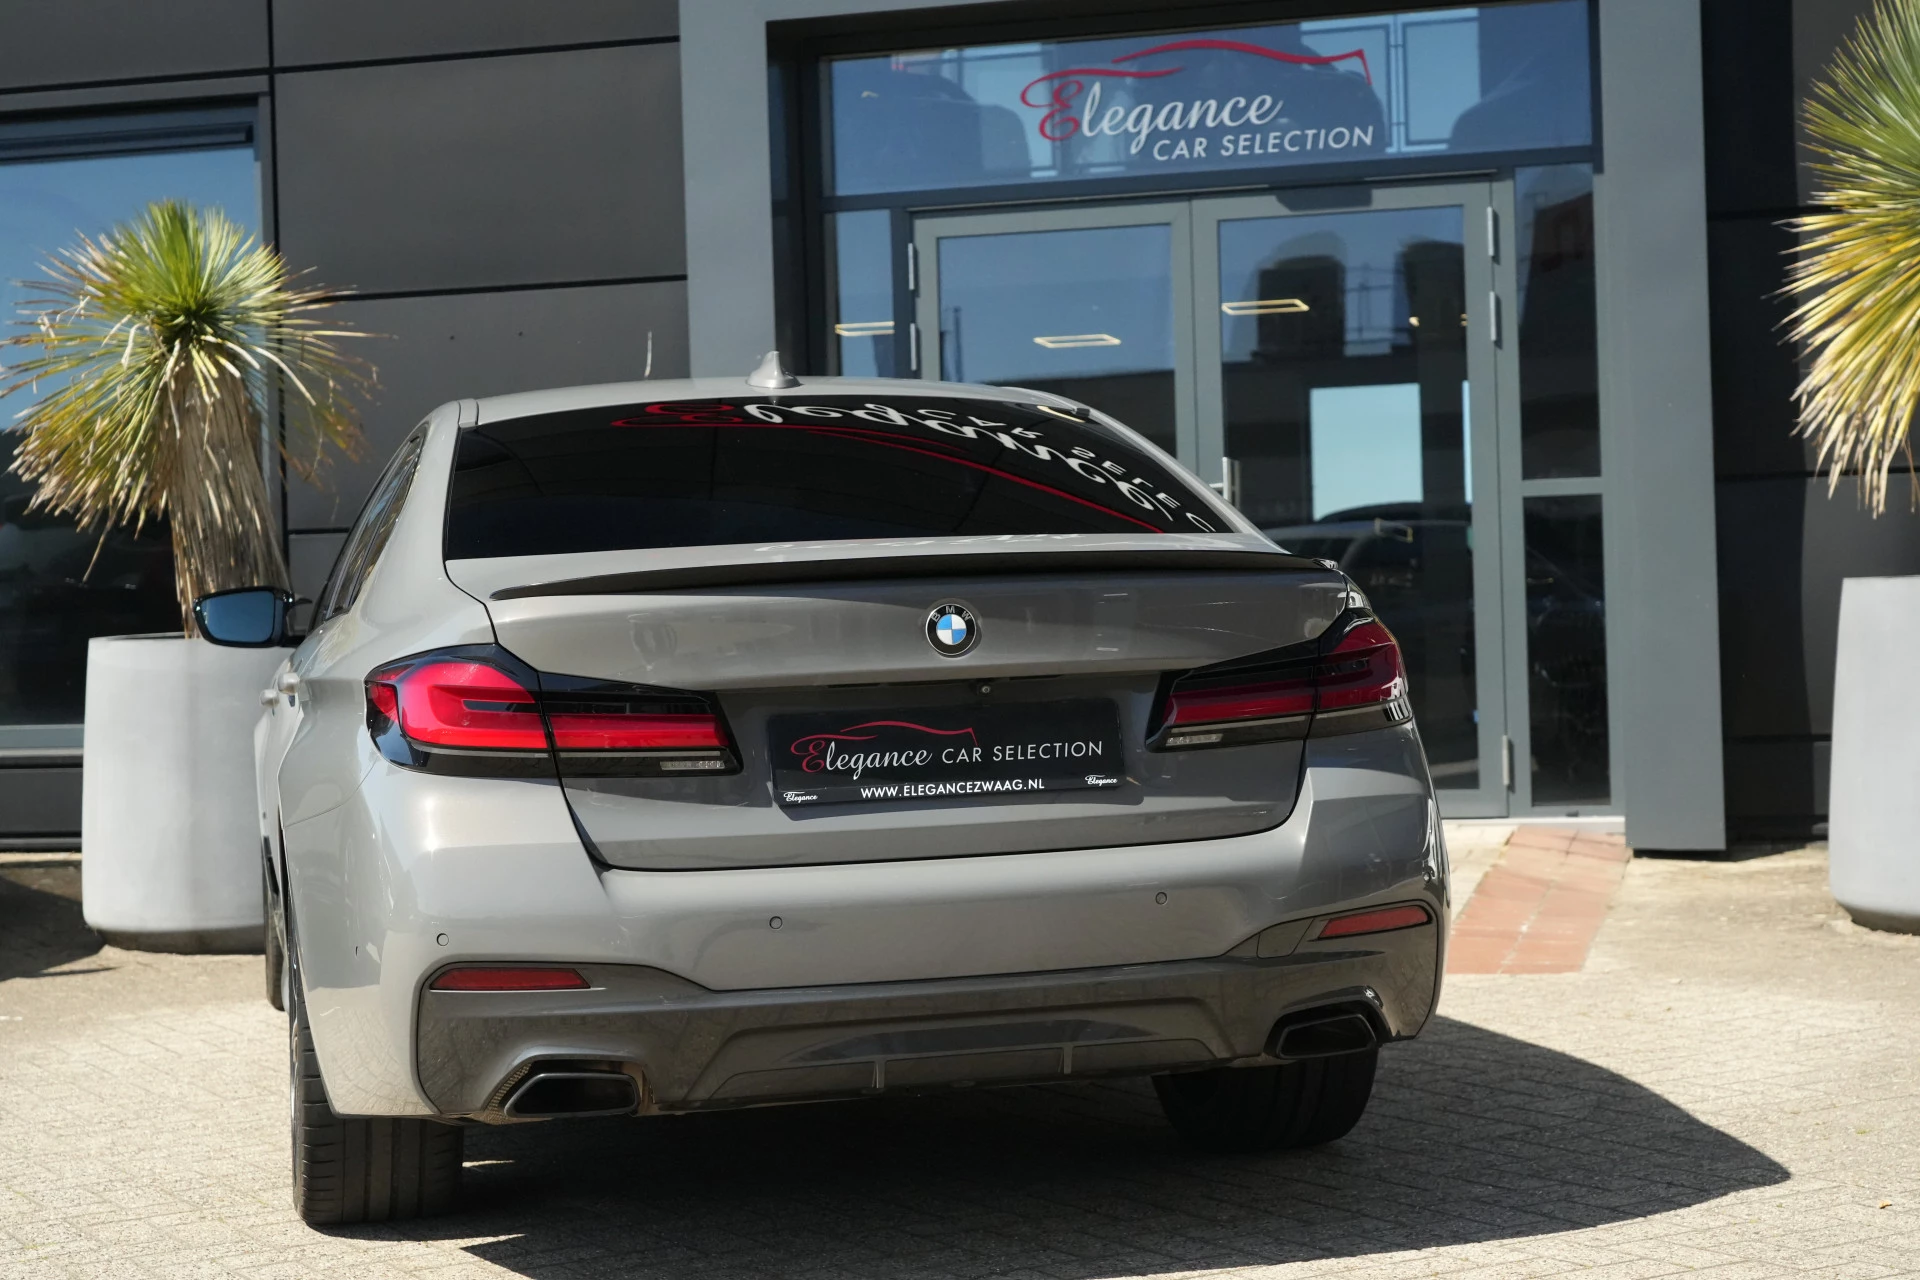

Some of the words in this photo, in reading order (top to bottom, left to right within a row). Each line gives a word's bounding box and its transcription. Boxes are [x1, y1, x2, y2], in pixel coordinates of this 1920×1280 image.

[1020, 69, 1283, 155] Elegance
[1153, 137, 1207, 161] CAR
[1220, 125, 1374, 157] SELECTION
[930, 605, 972, 623] BMW
[791, 734, 932, 780] Elegance
[942, 747, 982, 764] CAR
[992, 740, 1103, 762] SELECTION
[861, 778, 1045, 799] WWW.ELEGANCEZWAAG.NL
[1085, 774, 1118, 786] Elegance
[783, 791, 818, 803] Elegance
